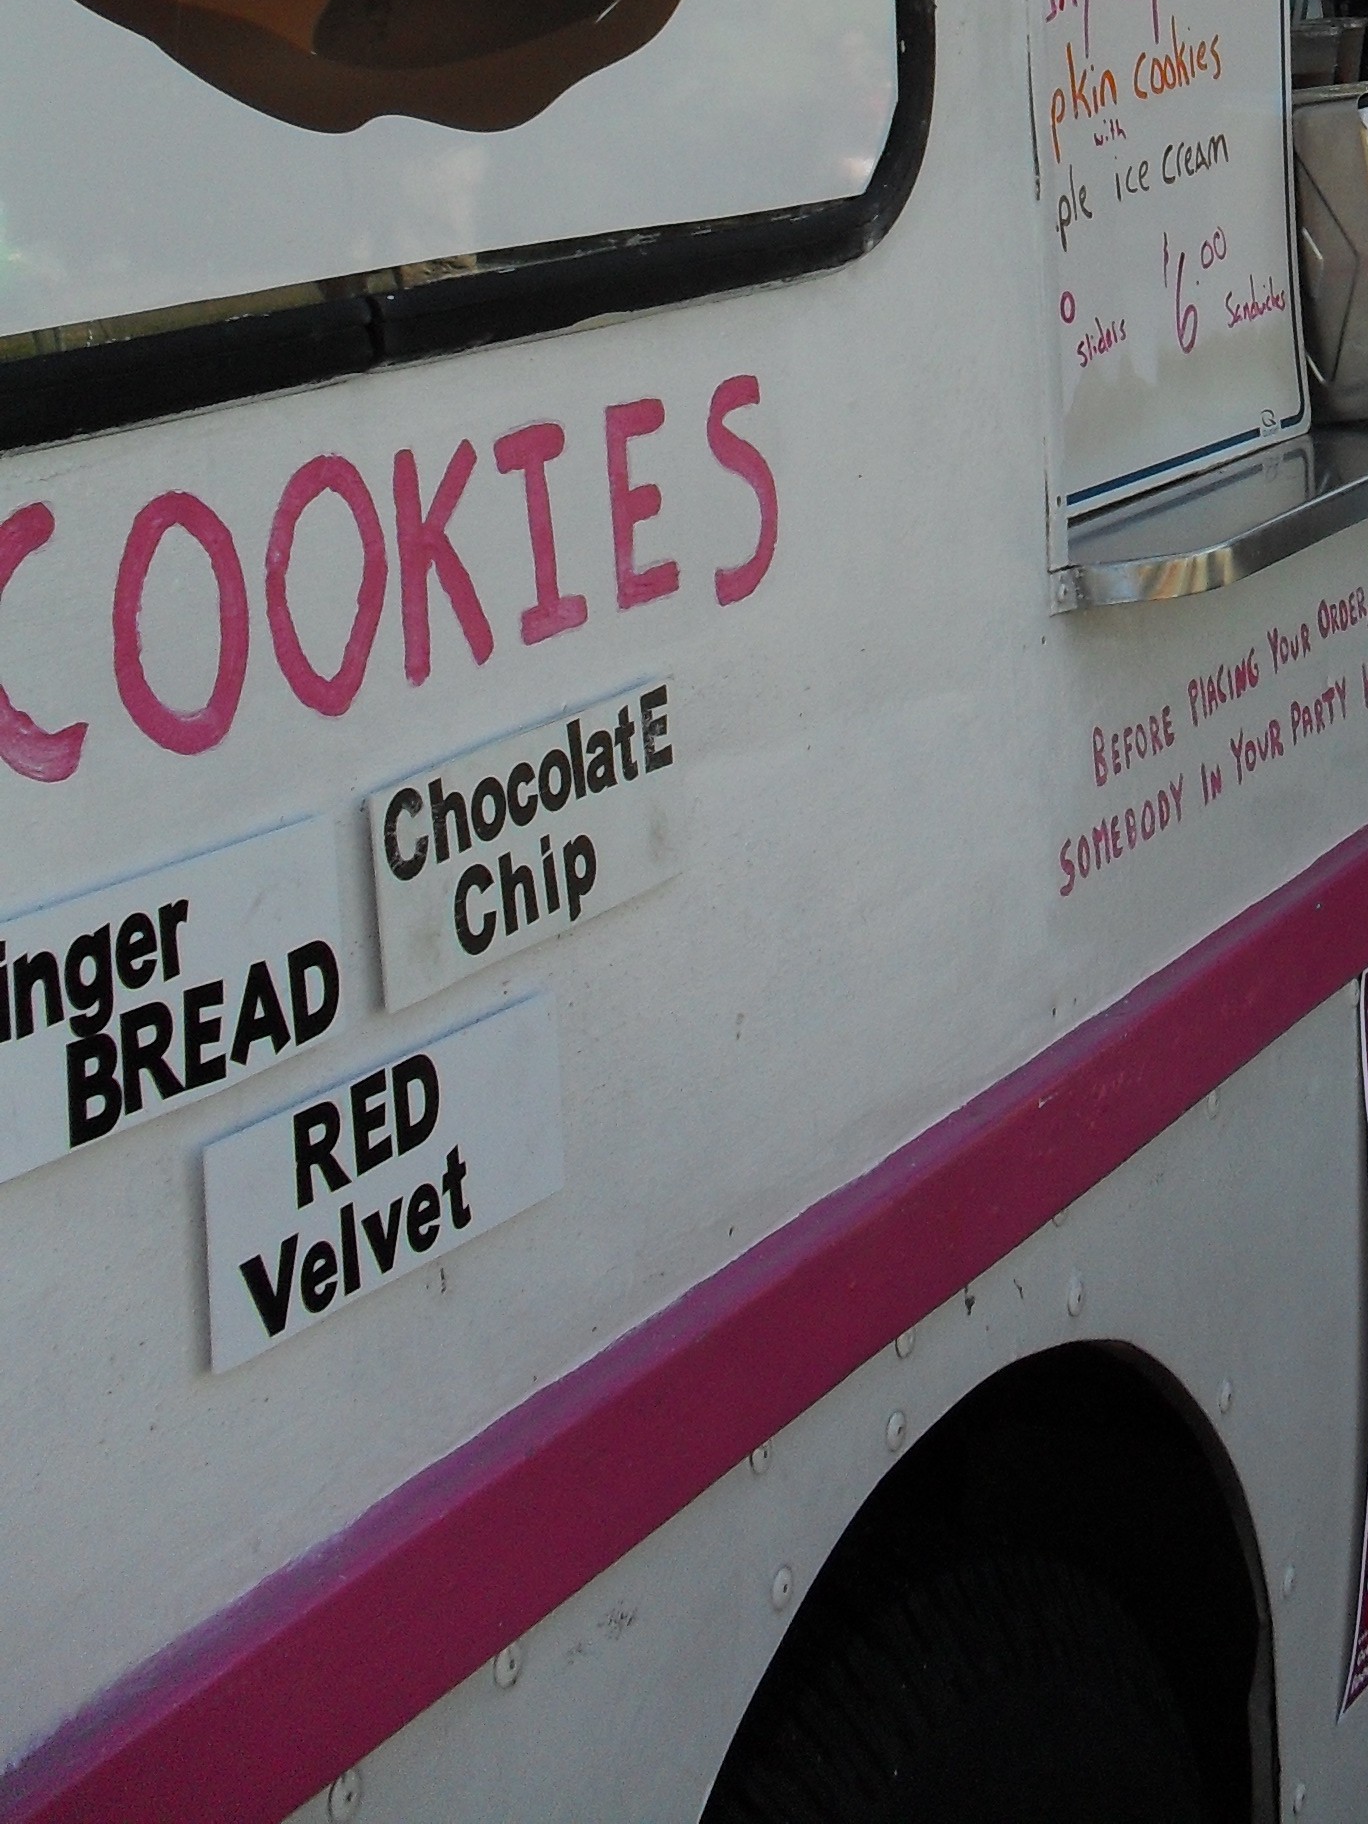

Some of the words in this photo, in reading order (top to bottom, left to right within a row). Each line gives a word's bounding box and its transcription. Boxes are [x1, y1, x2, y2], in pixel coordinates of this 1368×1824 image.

[1093, 118, 1126, 146] with
[1134, 15, 1222, 100] cookies
[1114, 155, 1150, 202] ice
[0, 374, 779, 782] COOKIES
[1092, 705, 1176, 787] BEFORE
[1187, 647, 1260, 727] PLACING
[1266, 622, 1311, 674] YOUR
[1059, 773, 1184, 897] SOMEBODY
[1202, 762, 1222, 806] IN
[1229, 718, 1285, 786] YOUR
[1290, 676, 1347, 746] PARTY
[453, 833, 597, 956] Chip
[66, 939, 340, 1149] BREAD
[292, 1052, 440, 1210] RED
[239, 1144, 472, 1338] Velvet
